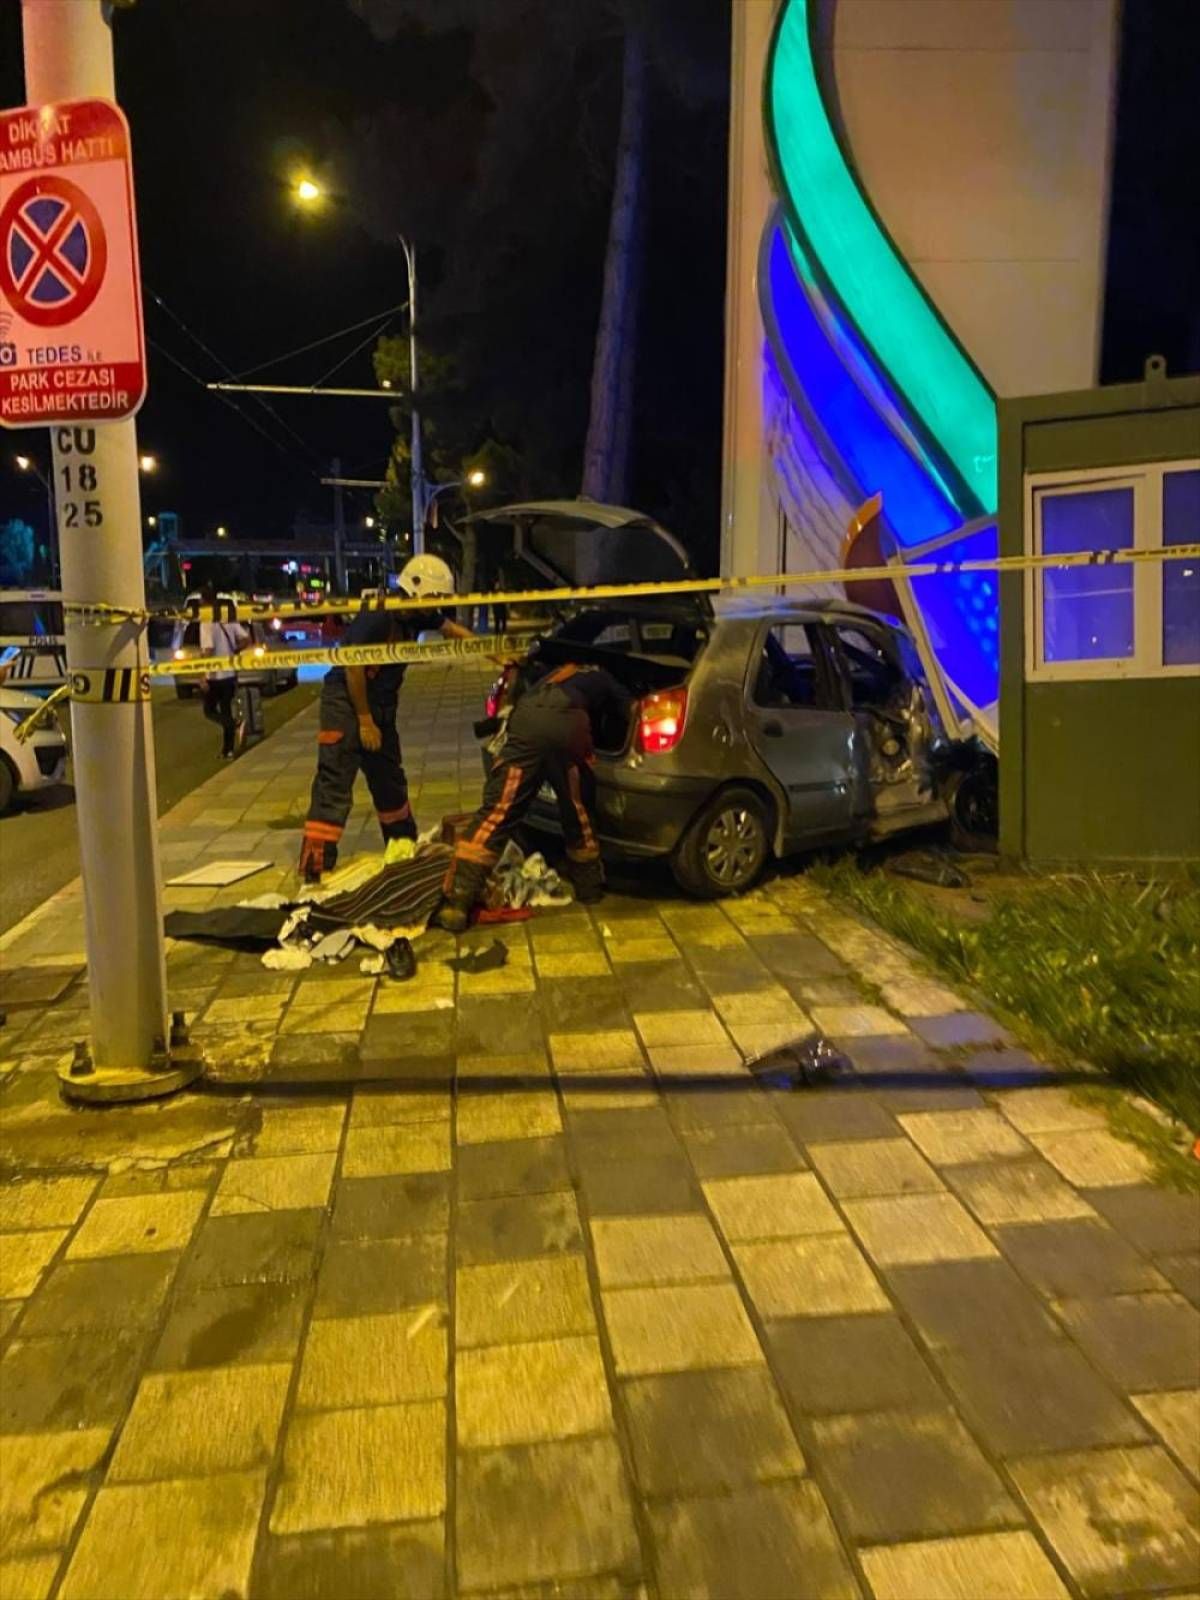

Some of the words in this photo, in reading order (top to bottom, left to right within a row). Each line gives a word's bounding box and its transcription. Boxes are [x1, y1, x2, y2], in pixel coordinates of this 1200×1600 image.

[8, 114, 72, 144] DİKAT
[25, 344, 82, 364] TEDES
[10, 371, 49, 392] PARK
[53, 367, 115, 389] CEZASI
[1, 387, 129, 415] KESİLMEKTEDİR
[57, 426, 96, 455] CU
[61, 463, 97, 492] 18
[64, 501, 103, 528] 25
